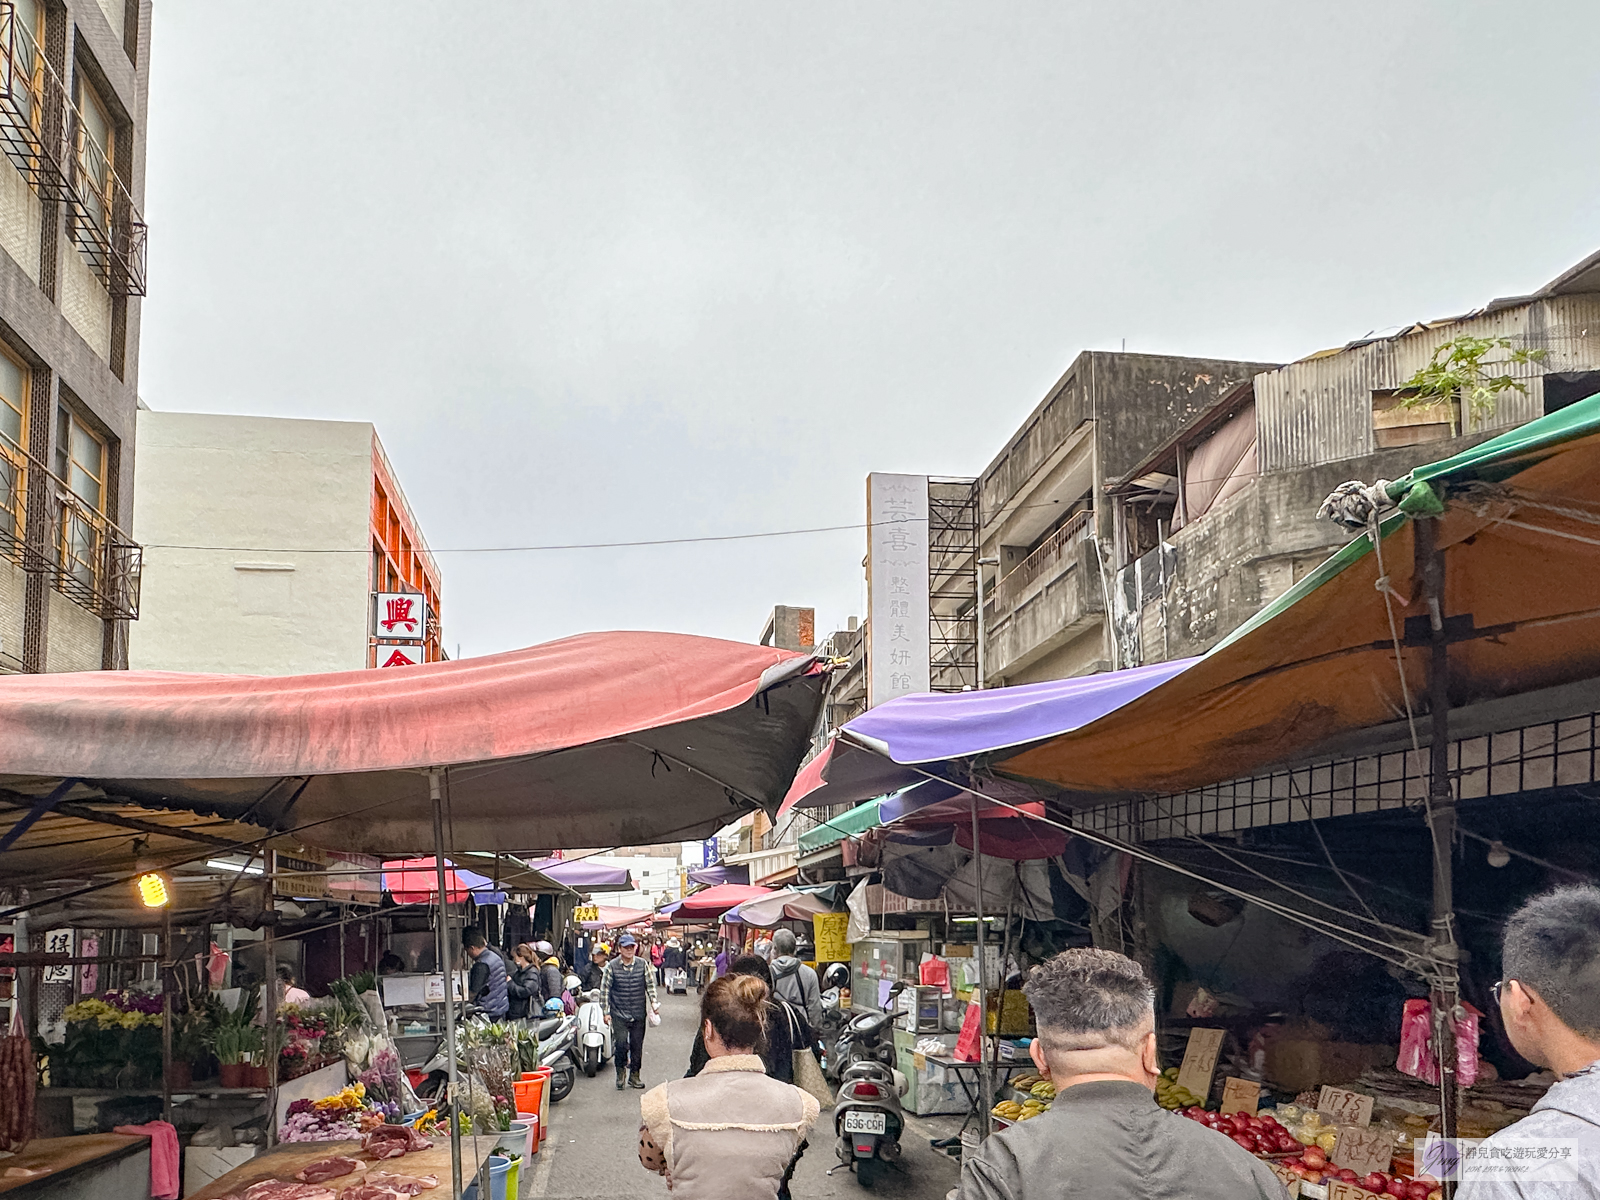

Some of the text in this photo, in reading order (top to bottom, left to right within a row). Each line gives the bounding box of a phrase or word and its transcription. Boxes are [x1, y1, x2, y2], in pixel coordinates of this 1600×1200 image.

[889, 576, 912, 690] 整體美妍館
